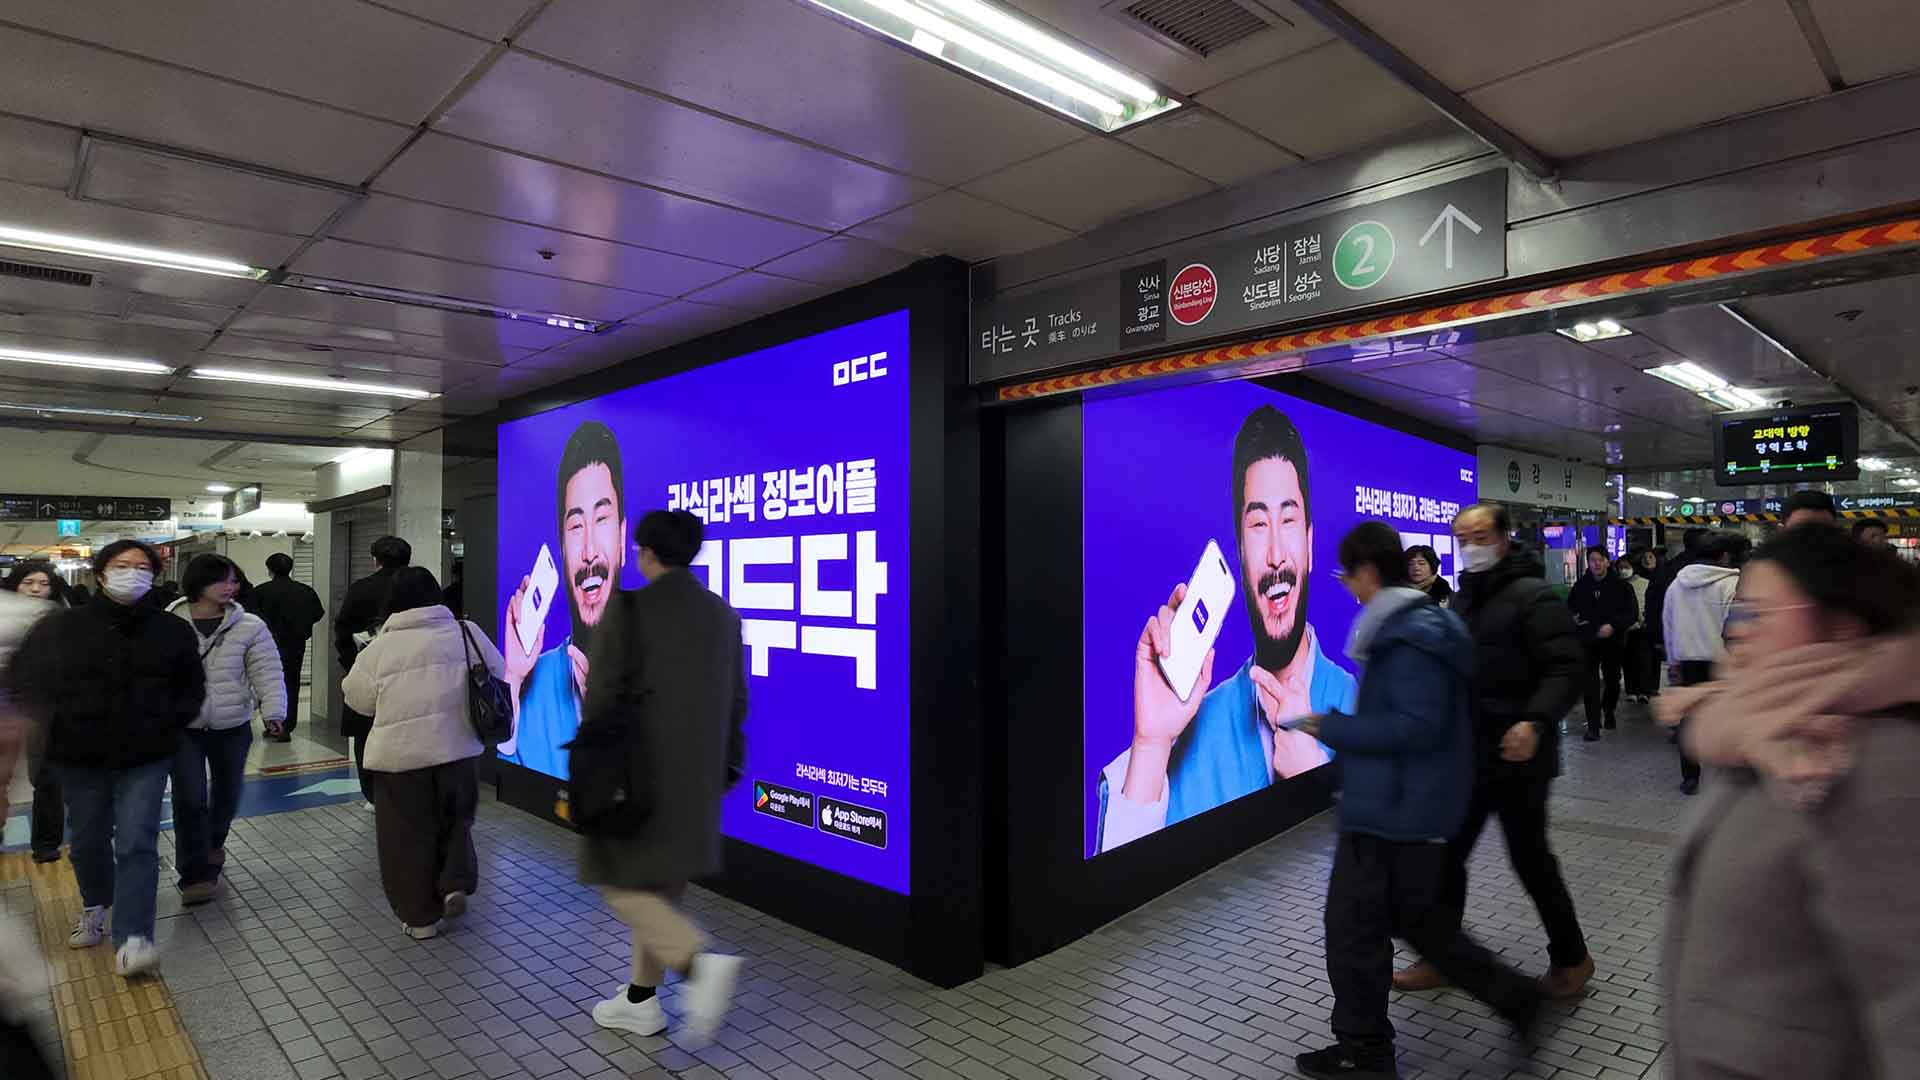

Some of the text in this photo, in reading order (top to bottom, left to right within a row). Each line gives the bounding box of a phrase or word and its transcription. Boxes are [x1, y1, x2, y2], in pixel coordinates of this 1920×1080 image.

[1254, 244, 1280, 265] 사당
[1294, 233, 1321, 257] 잠실
[1351, 234, 1376, 276] 2
[1253, 263, 1280, 275] Sadang
[1299, 253, 1322, 265] Jamsil
[1137, 274, 1161, 293] 신사
[1173, 276, 1212, 301] 신분당선
[1242, 279, 1280, 304] 신도림
[1294, 271, 1322, 293] 성수
[1249, 298, 1281, 311] Sindorim
[1288, 290, 1321, 303] Seongsu
[1048, 308, 1081, 328] Tracks
[1137, 304, 1160, 322] 광교
[982, 317, 1040, 354] 타는 곳
[1125, 322, 1160, 335] Gwanggyo
[1752, 425, 1810, 439] 교대역 방향
[667, 458, 877, 525] 라식라섹 정보어플
[1355, 485, 1392, 518] 라식라섹
[690, 530, 888, 690] 두닥
[795, 762, 889, 799] 라식라섹 최저가는 모두닥
[769, 789, 789, 804] Google
[833, 807, 882, 830] App Store에서
